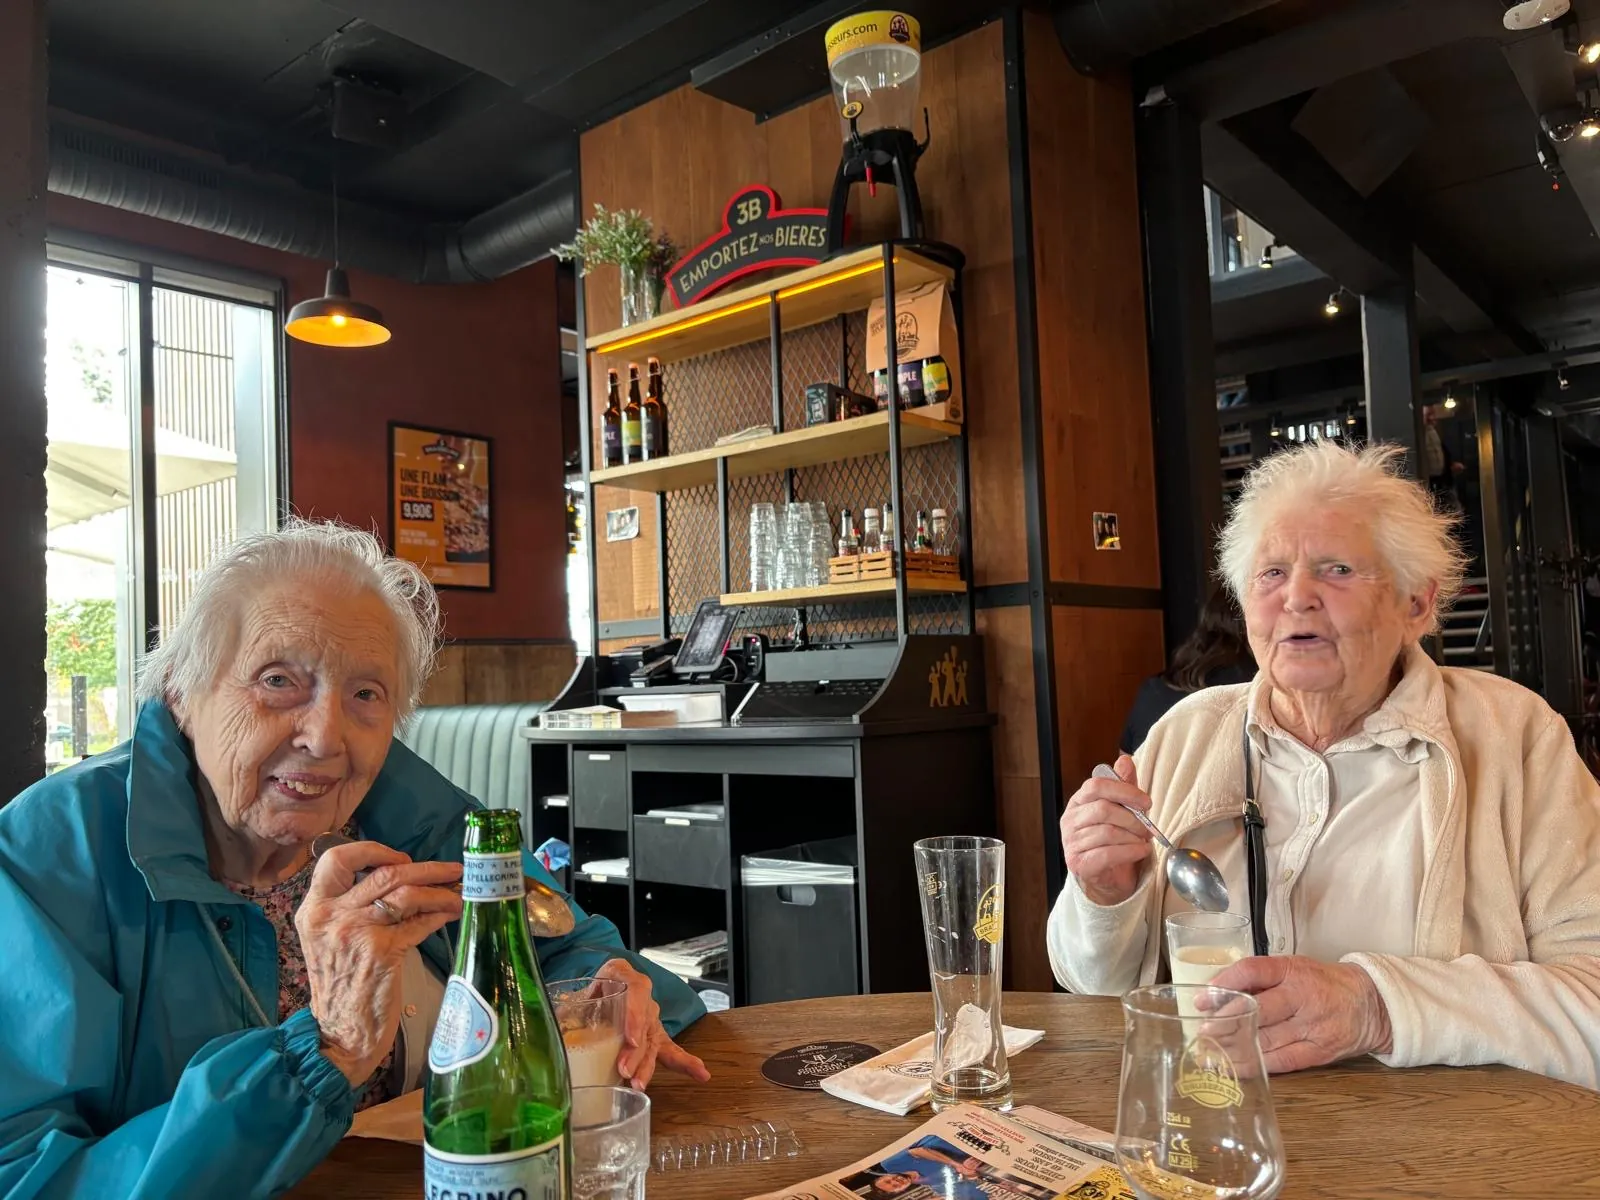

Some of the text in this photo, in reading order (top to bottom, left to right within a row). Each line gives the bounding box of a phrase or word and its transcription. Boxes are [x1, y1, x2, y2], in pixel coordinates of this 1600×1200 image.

[736, 198, 762, 226] 3B
[680, 225, 827, 294] EMPORTEZ NOS BIERES
[400, 468, 419, 483] UNE
[400, 483, 420, 497] UNE
